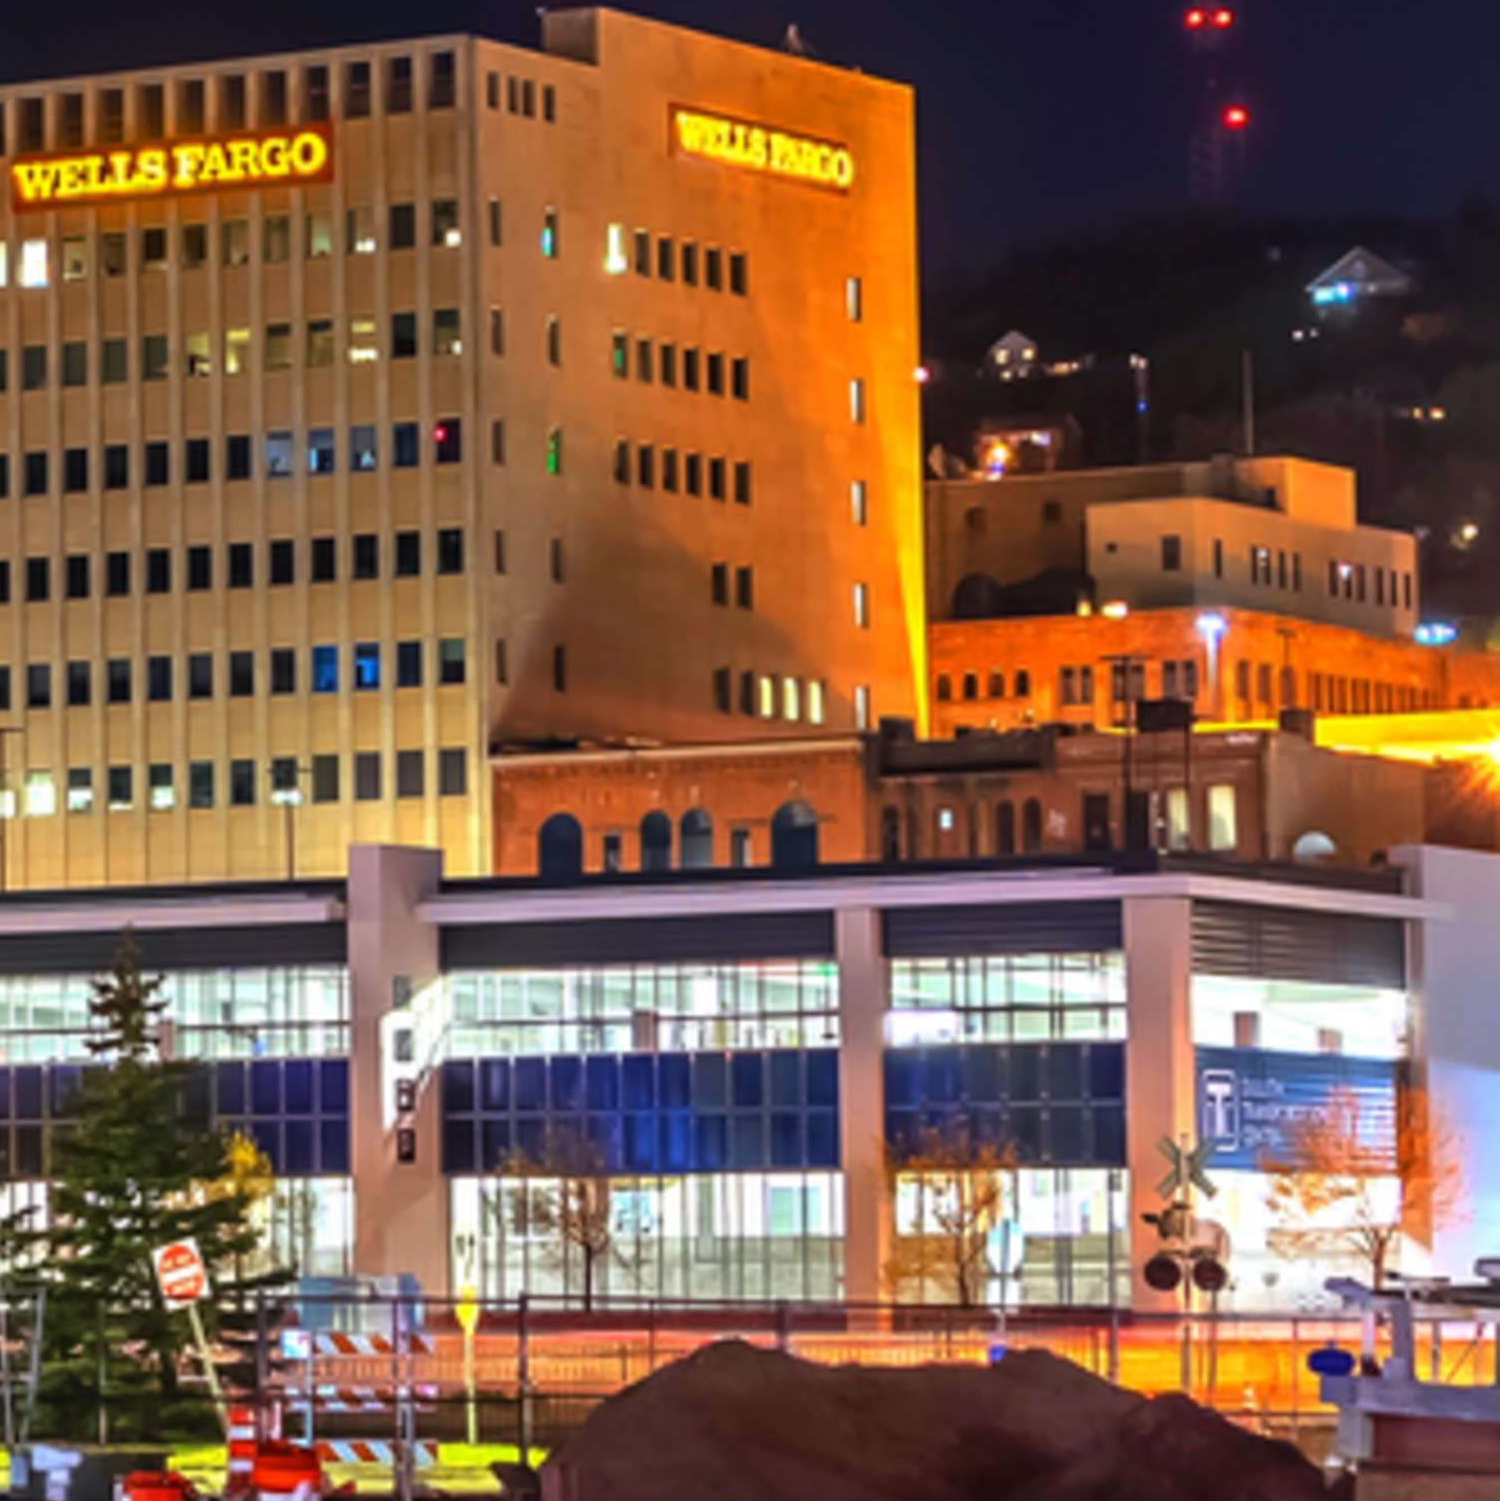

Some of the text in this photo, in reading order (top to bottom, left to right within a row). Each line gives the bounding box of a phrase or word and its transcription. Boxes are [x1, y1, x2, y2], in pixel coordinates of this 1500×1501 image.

[13, 132, 327, 201] WELLS FARGO
[675, 111, 854, 188] WELLS FARGO
